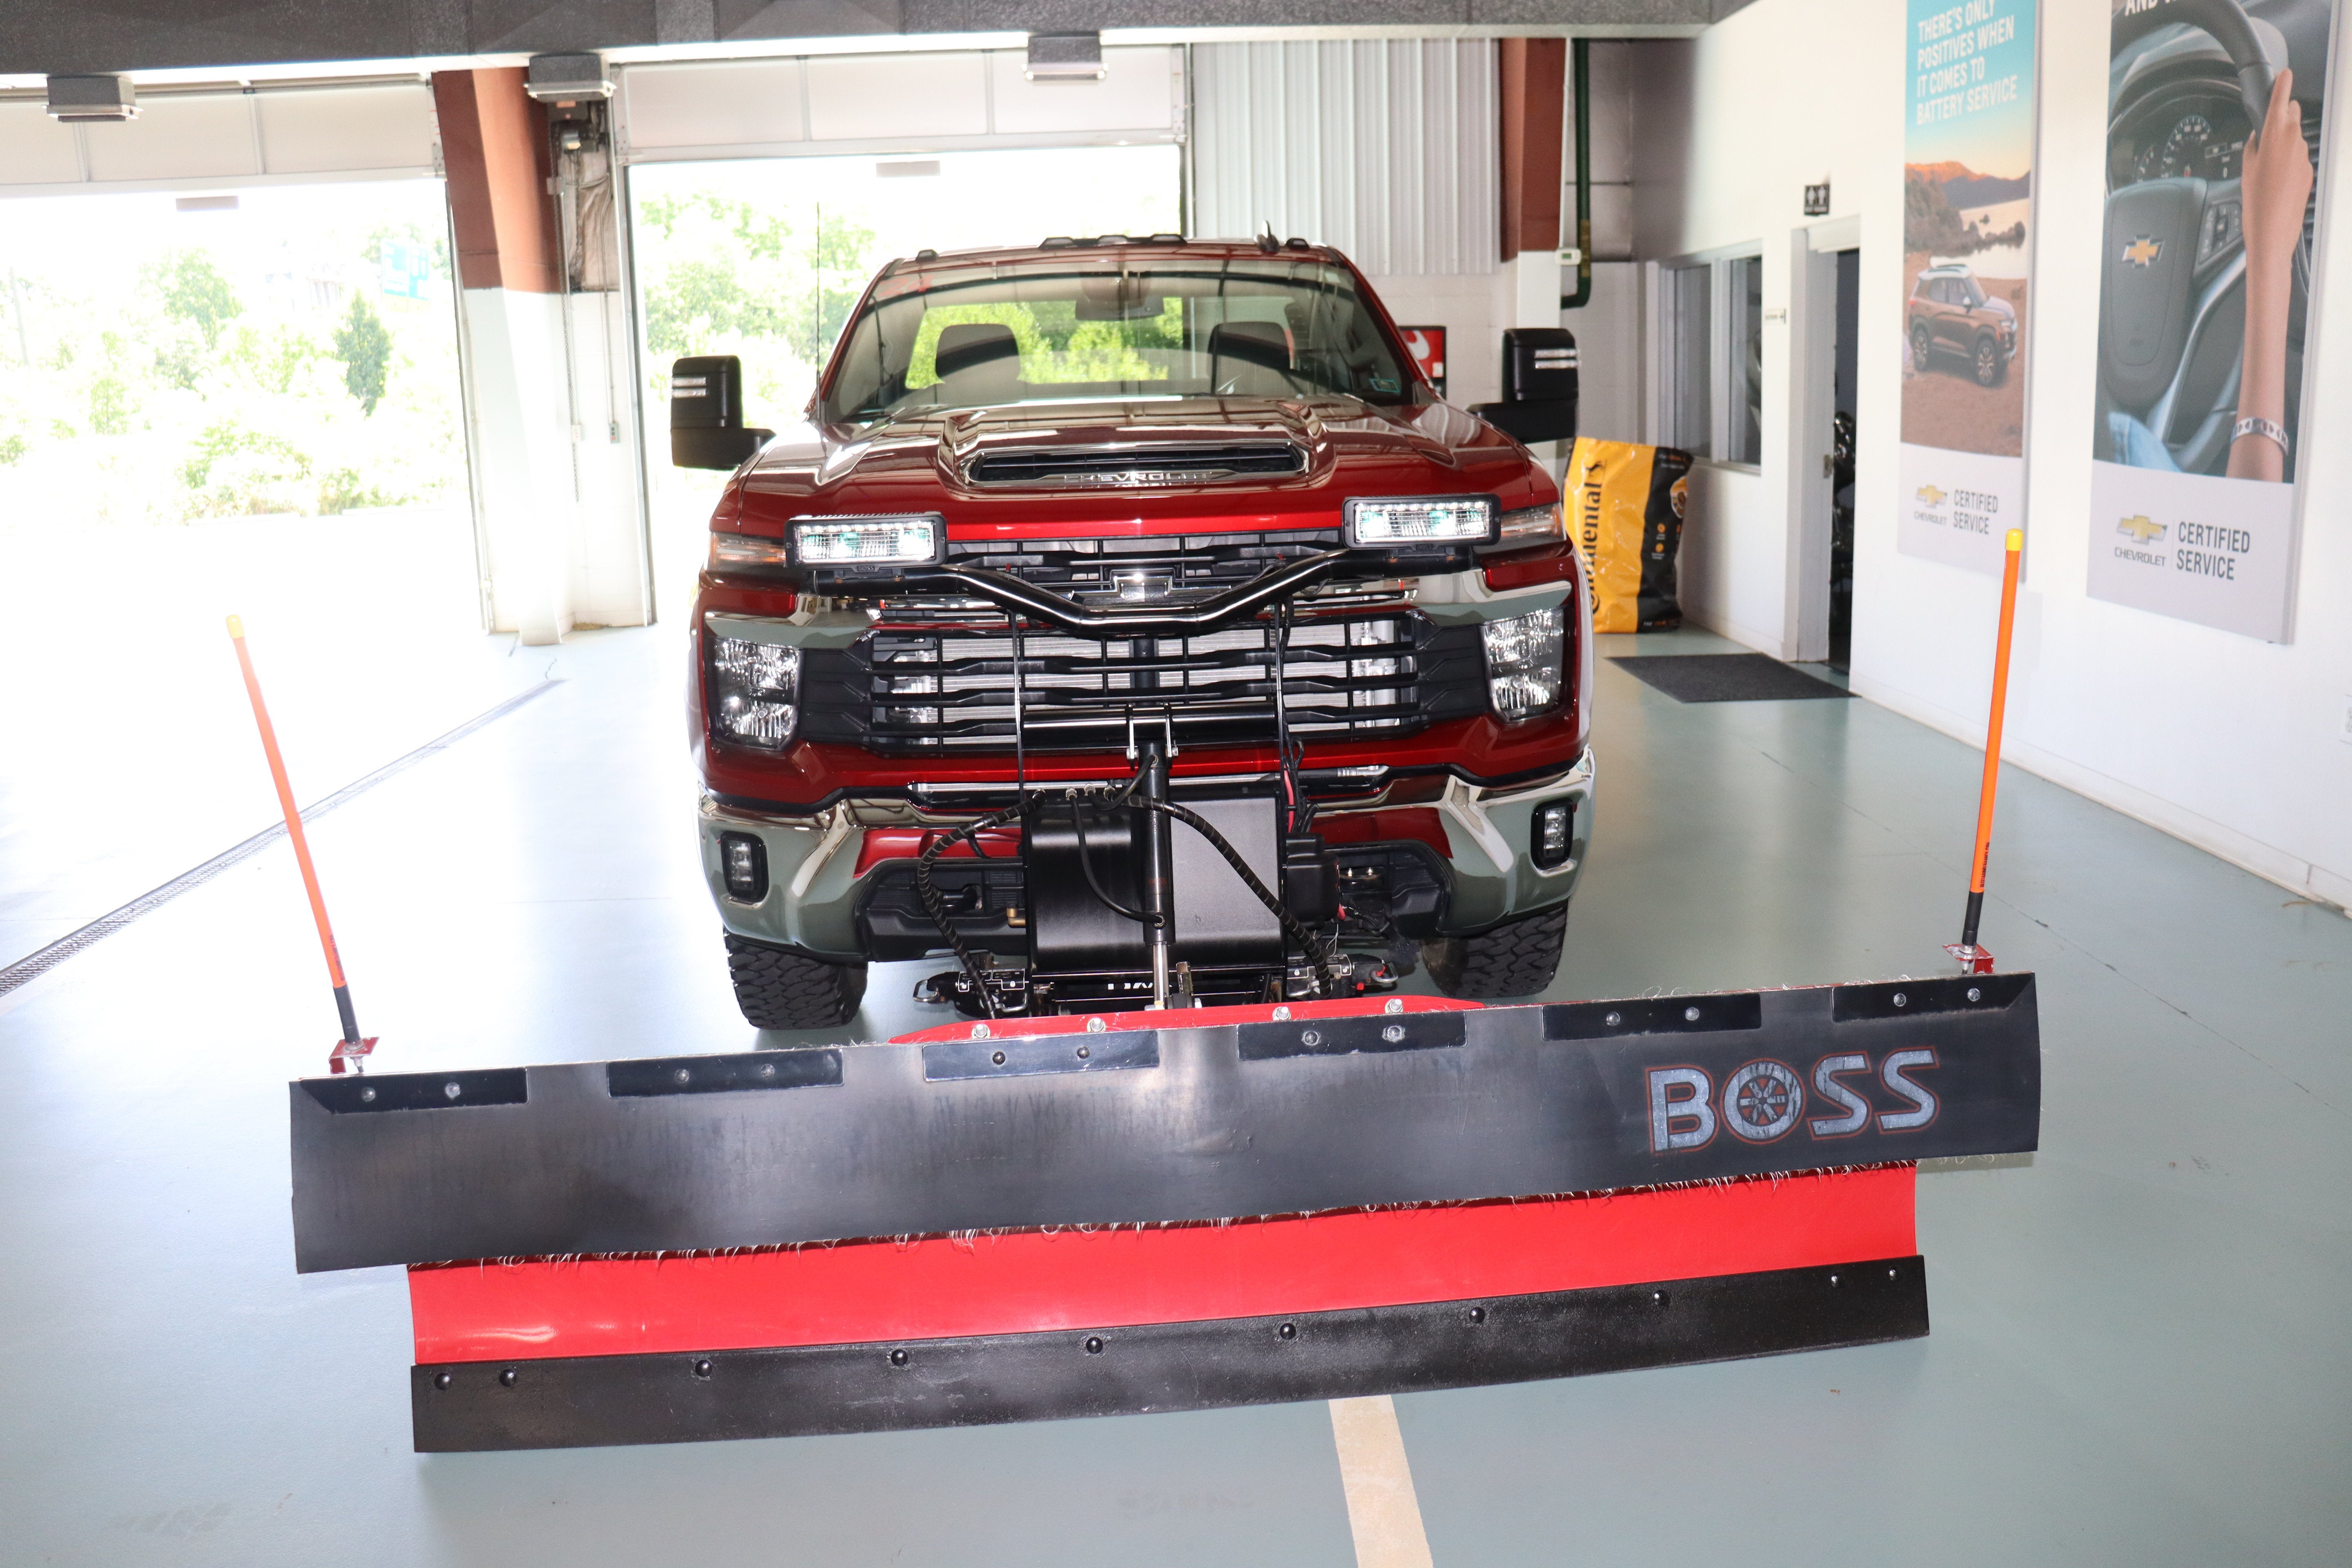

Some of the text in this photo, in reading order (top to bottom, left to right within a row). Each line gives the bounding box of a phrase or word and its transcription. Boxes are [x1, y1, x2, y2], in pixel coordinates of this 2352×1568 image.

[1918, 0, 1995, 43] THERE'S ONLY
[1917, 15, 2015, 71] POSITIVES WHEN
[1917, 56, 1985, 98] IT COMES TO
[1917, 75, 2018, 125] BATTERY SERVICE
[1914, 511, 1947, 526] CHEVROLET
[1954, 489, 1998, 513] CERTIFIED
[1953, 511, 1989, 535] SERVICE
[2178, 521, 2251, 554] CERTIFIED
[1582, 482, 1602, 615] inental
[2114, 547, 2167, 567] CHEVROLET
[2176, 549, 2236, 580] SERVICE
[1645, 1046, 1940, 1156] BOSS
